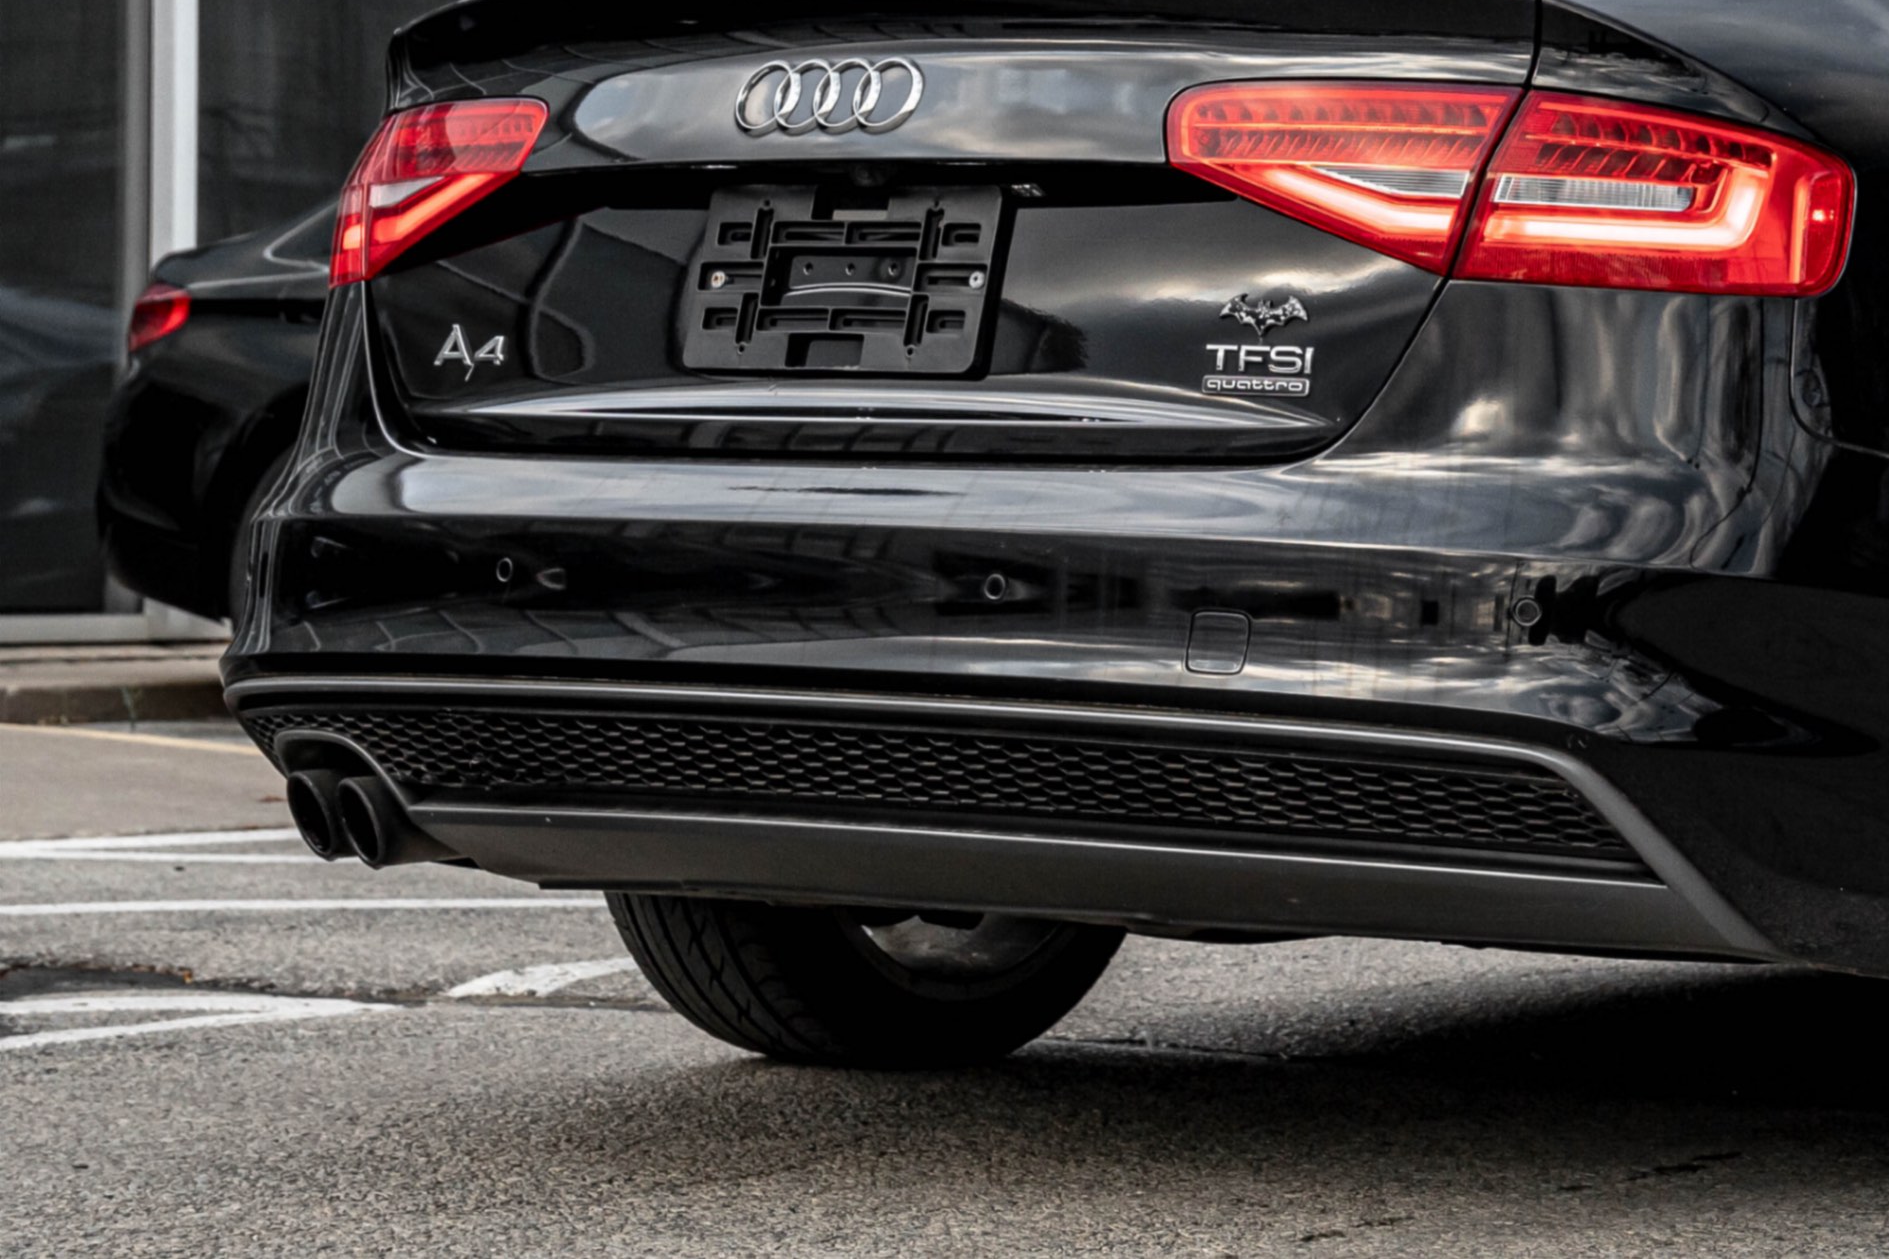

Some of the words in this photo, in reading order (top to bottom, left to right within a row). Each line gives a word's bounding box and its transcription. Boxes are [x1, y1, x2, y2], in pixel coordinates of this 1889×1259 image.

[433, 324, 505, 382] A4
[1205, 344, 1314, 374] TFSI
[1206, 379, 1304, 391] quattro
